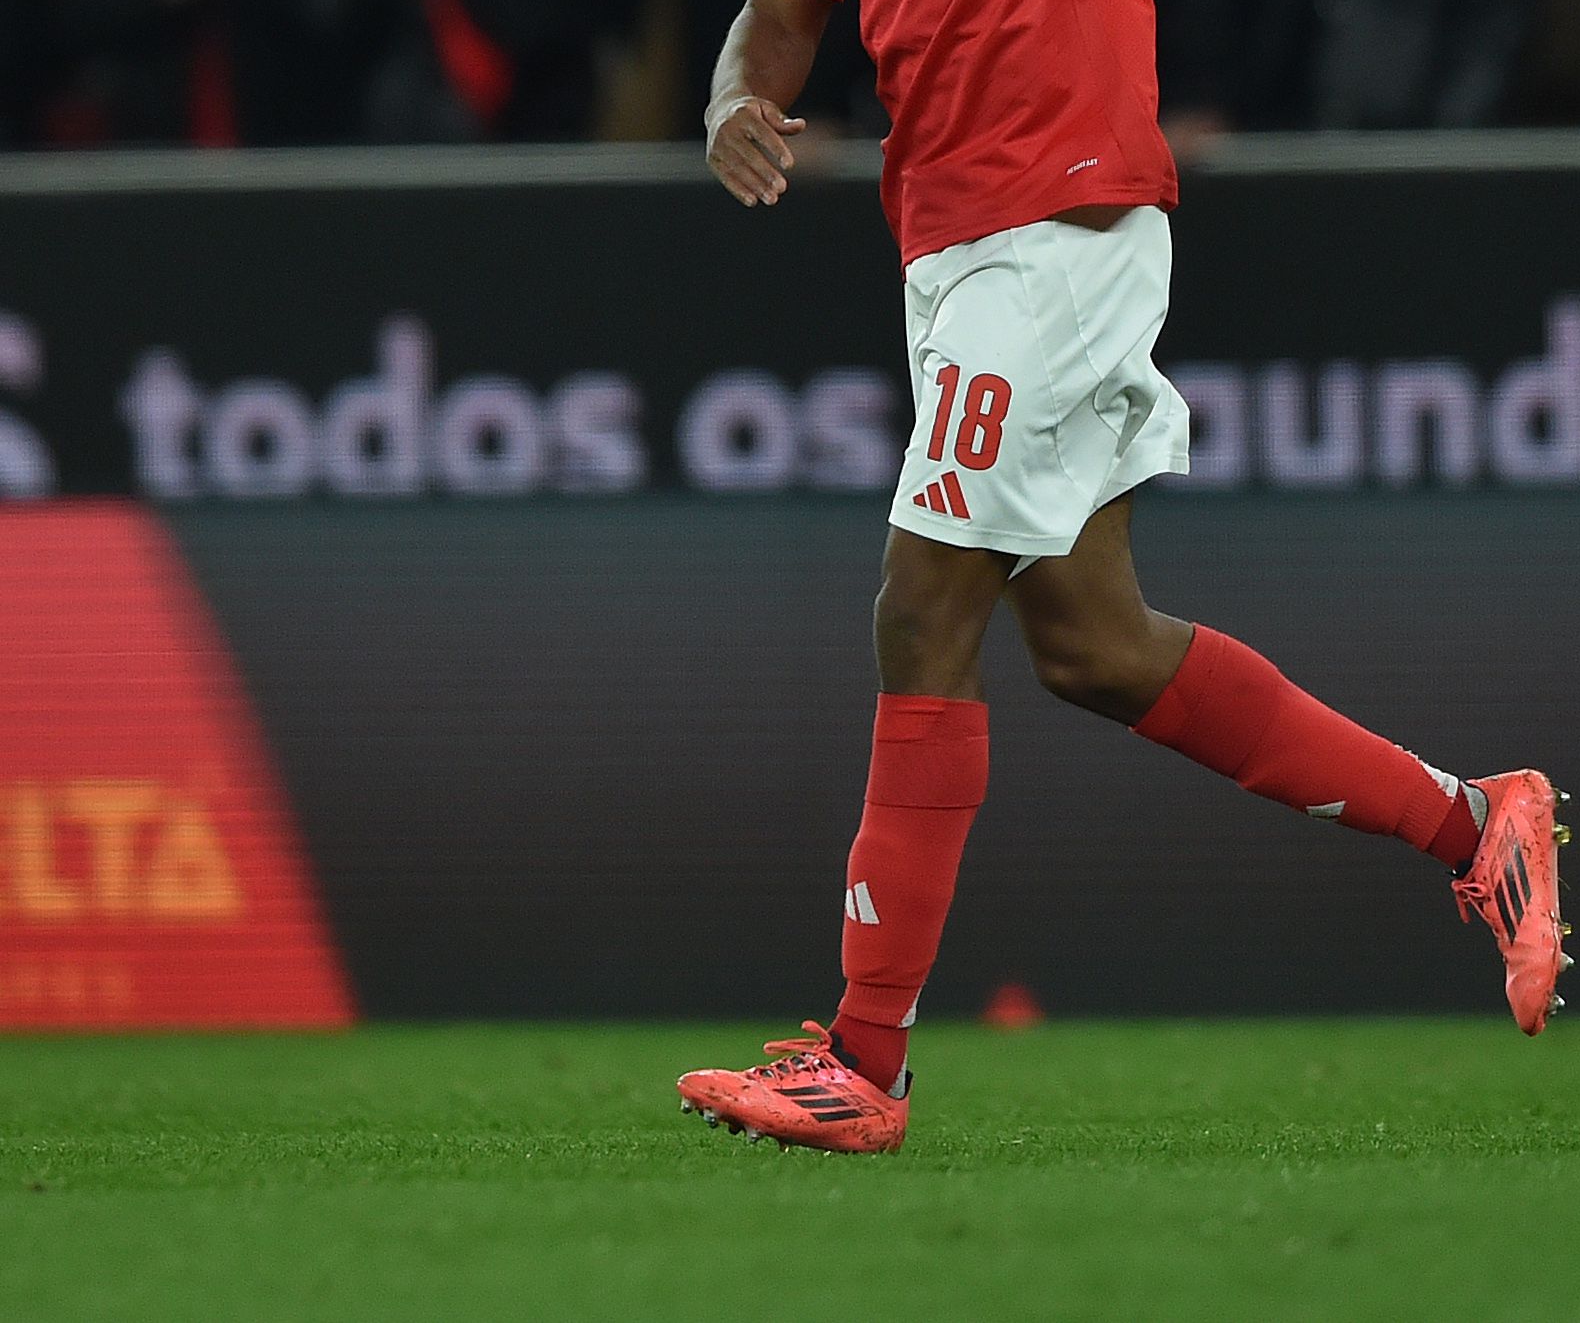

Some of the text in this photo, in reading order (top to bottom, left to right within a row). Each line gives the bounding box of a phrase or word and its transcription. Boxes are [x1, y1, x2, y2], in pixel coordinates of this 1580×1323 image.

[124, 316, 640, 494] todos
[678, 372, 893, 492] os
[927, 363, 1012, 471] 18
[0, 778, 244, 918] LTA
